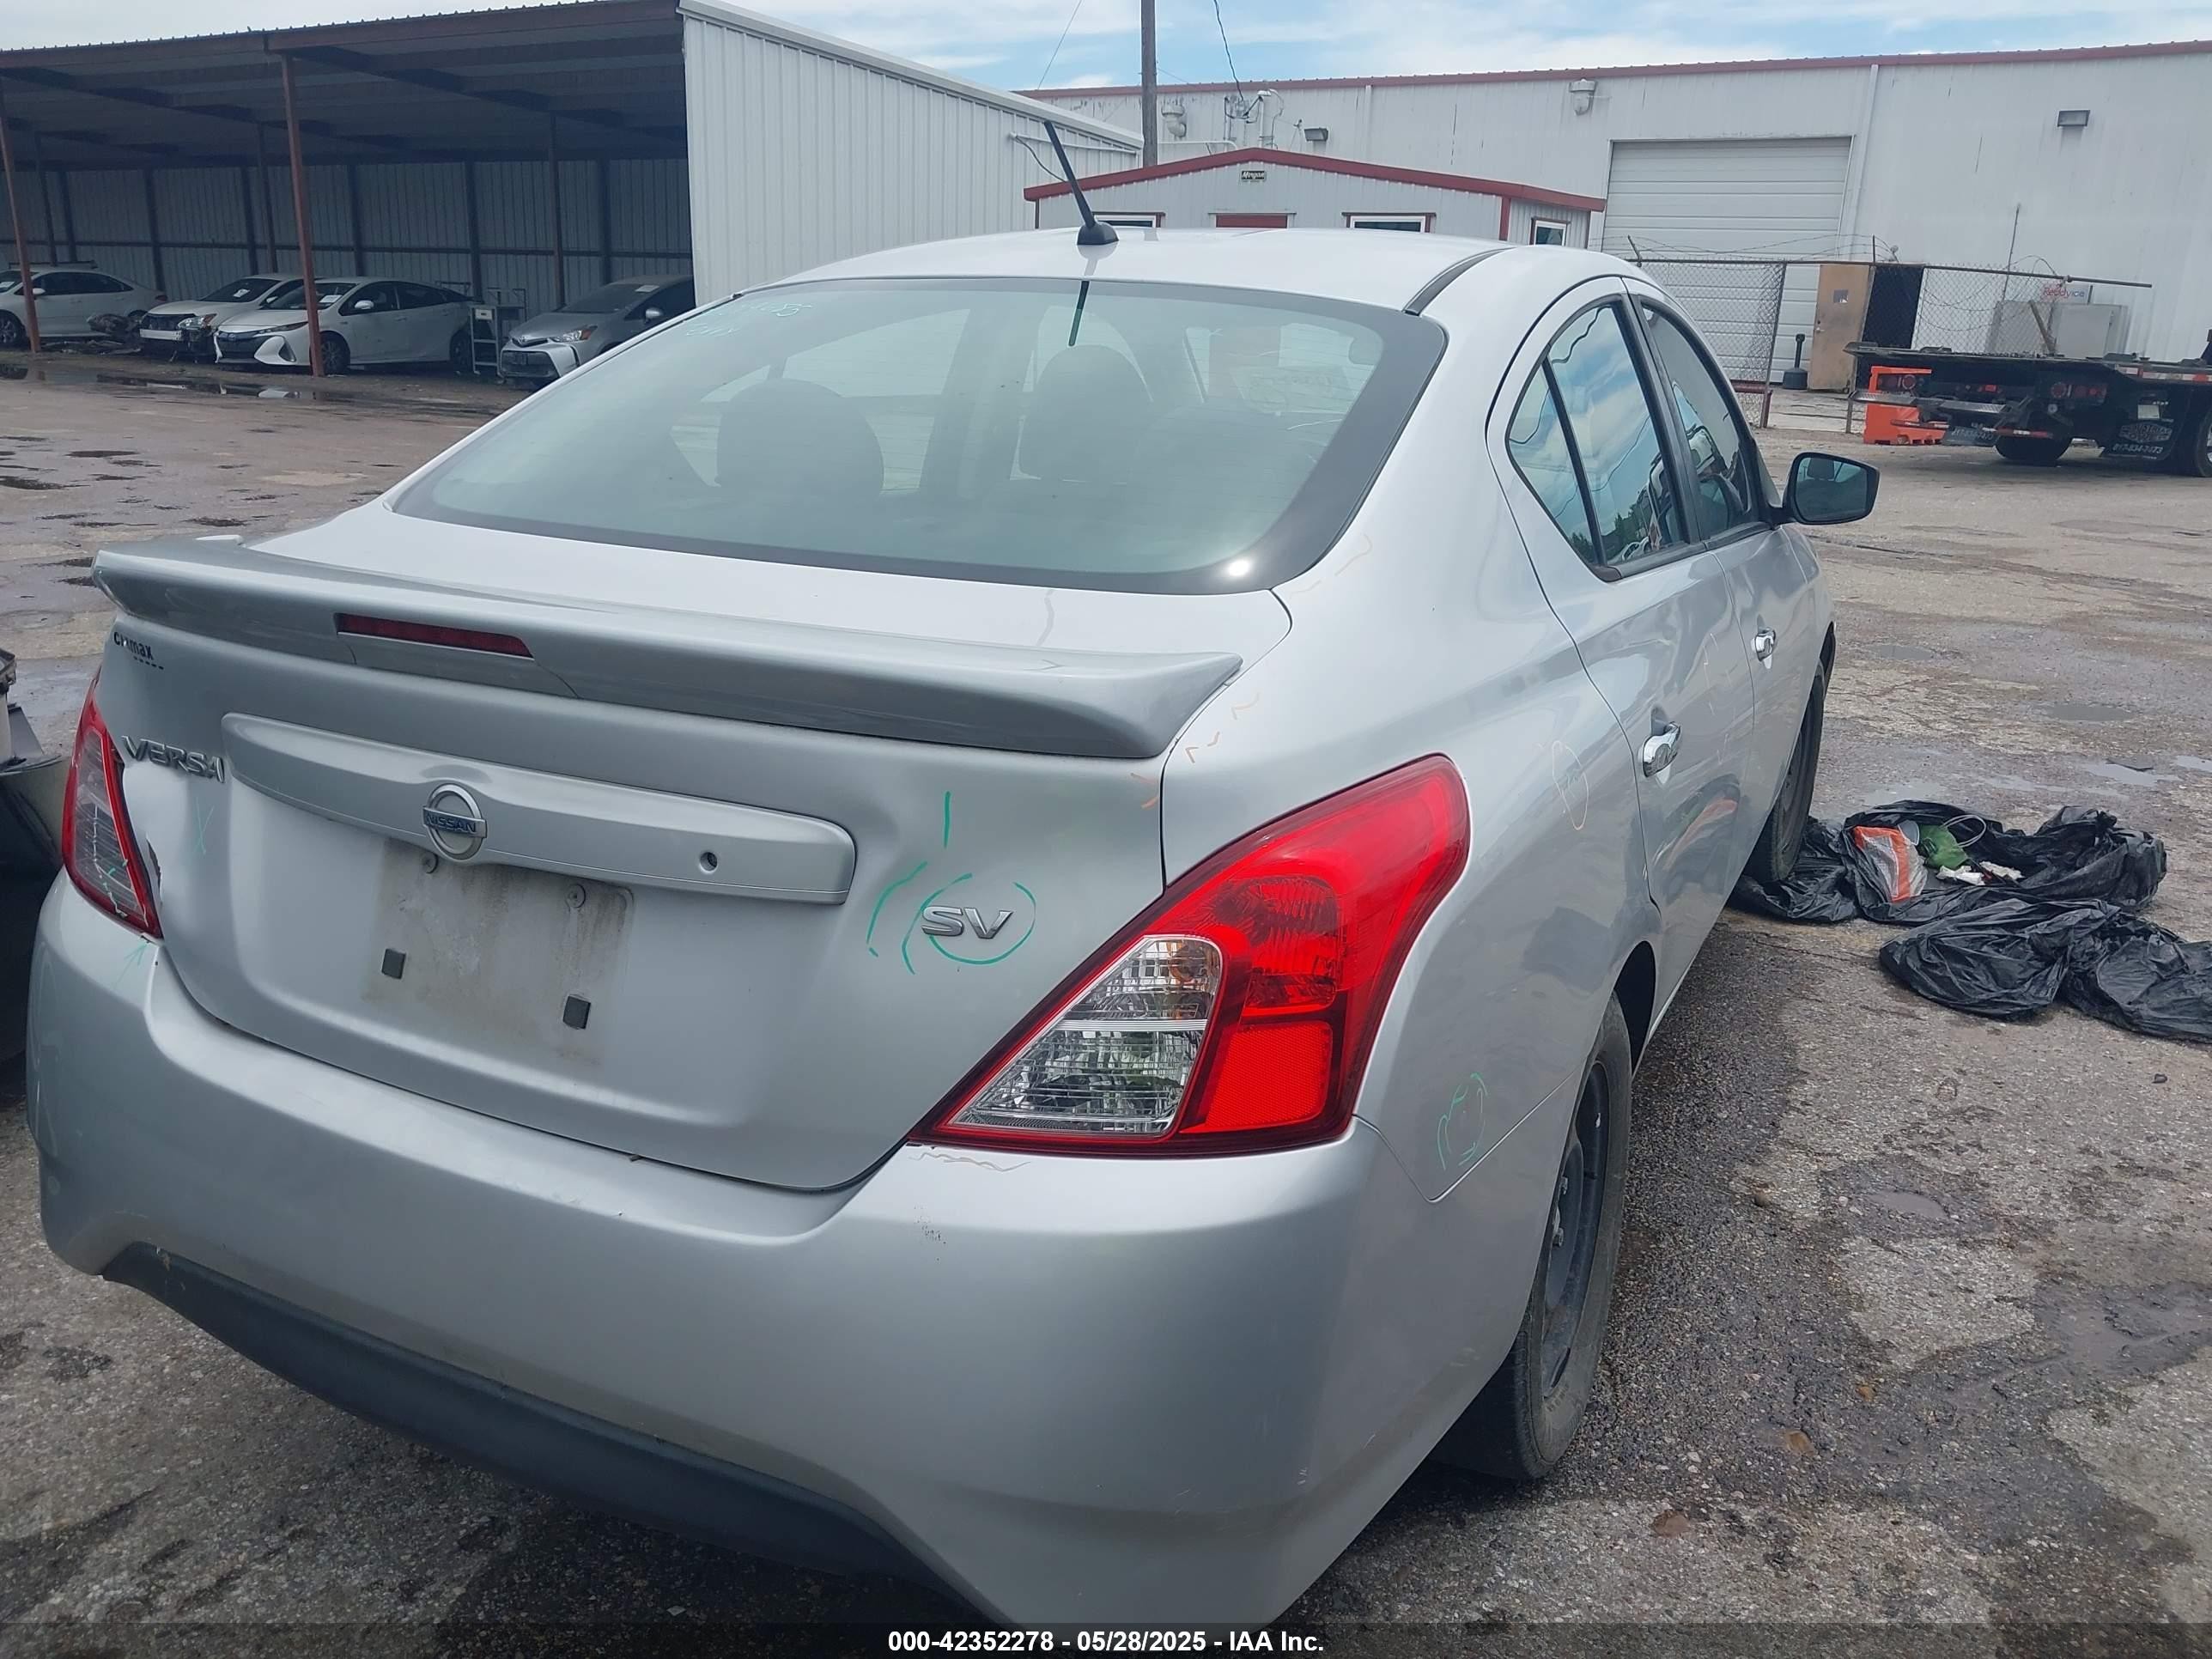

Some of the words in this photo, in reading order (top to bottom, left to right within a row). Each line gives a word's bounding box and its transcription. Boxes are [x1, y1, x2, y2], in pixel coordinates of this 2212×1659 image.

[121, 735, 225, 783] VERSA
[425, 811, 477, 835] NISSAN
[921, 905, 1014, 939] SV
